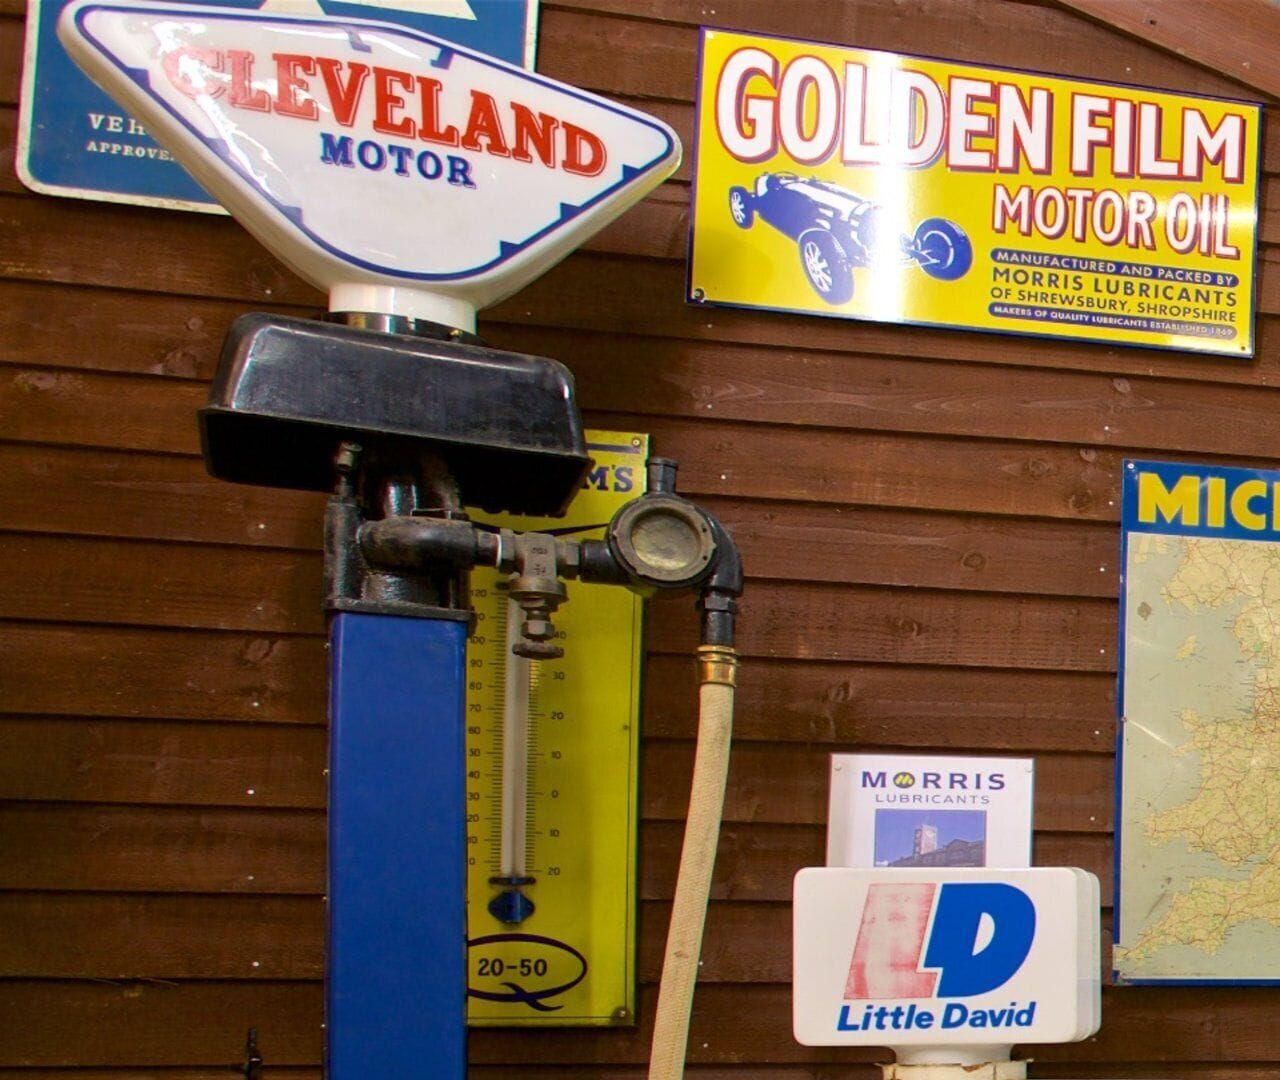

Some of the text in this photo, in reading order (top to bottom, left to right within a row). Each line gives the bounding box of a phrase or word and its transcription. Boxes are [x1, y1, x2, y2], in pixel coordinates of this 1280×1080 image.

[162, 45, 609, 178] CLEVELAND
[715, 47, 1247, 184] GOLDEN FILM
[320, 133, 477, 189] MOTOR
[992, 184, 1240, 260] MOTOR OIL
[997, 251, 1234, 286] MANUFACTURED AND PACKED BY
[993, 267, 1237, 307] MORRIS LUBRICANTS
[991, 287, 1236, 323] OF SHREWSBURY, SHROPSHIRE
[994, 306, 1233, 337] MAKERS OF QUALITY LUBRICANTS ESTABLISHED 1869
[862, 771, 1006, 791] MORRIS
[875, 794, 990, 805] LUBRICANTS
[477, 957, 549, 978] 20-50
[836, 1001, 1037, 1031] Little David
